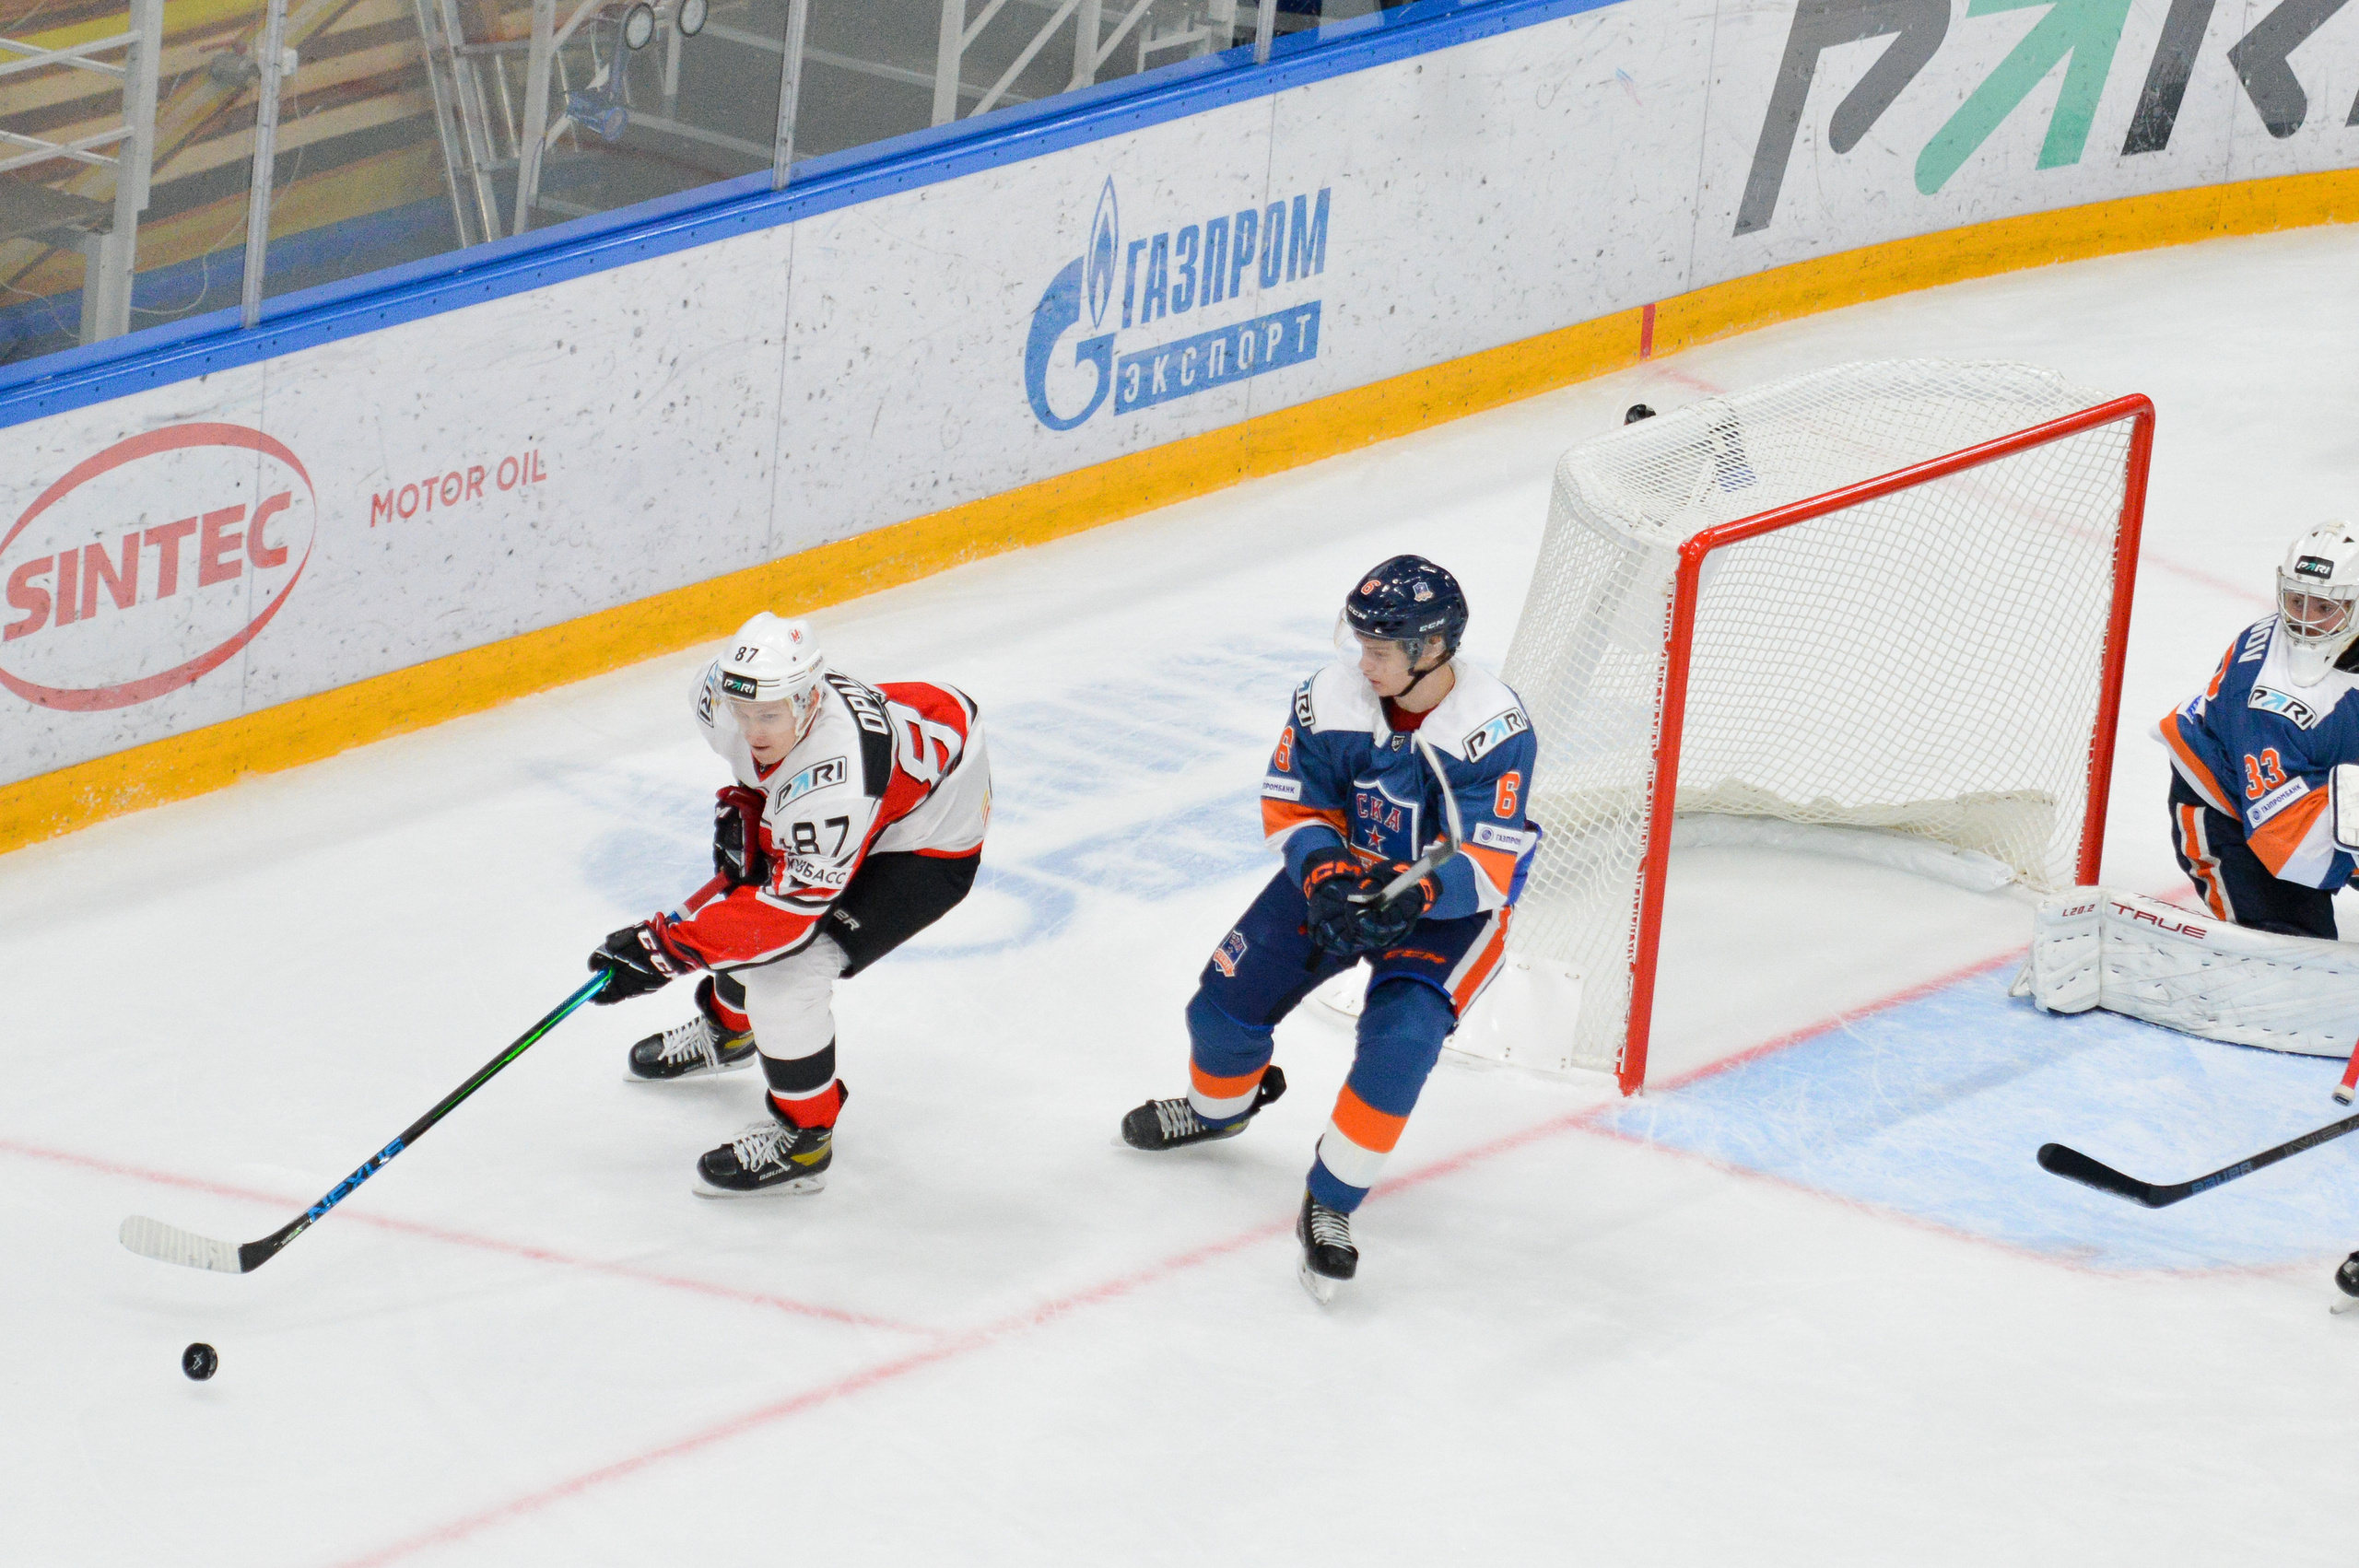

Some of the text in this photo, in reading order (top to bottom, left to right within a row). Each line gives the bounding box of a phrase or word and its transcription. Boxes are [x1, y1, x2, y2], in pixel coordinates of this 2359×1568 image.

[1121, 187, 1331, 330] ГАЗПРОМ
[1124, 314, 1310, 404] ЭКСПОРТ
[370, 450, 547, 528] MOTOR OIL
[3, 490, 292, 642] SINTEC
[1361, 579, 1381, 595] 6
[2296, 561, 2330, 575] PARI
[1347, 604, 1367, 620] CCM
[1418, 618, 1445, 632] CCM
[734, 646, 759, 663] 87
[2237, 614, 2279, 663] NOV
[723, 678, 755, 694] PARI
[2254, 689, 2314, 727] PARI
[1273, 725, 1294, 773] 6
[1467, 710, 1526, 758] PARI
[777, 760, 843, 809] PARI
[1493, 771, 1520, 819] 6
[2243, 748, 2287, 801] 33
[1356, 793, 1402, 833] СКА
[2260, 784, 2302, 814] ГАЗПРОМБАНК
[792, 815, 850, 859] 87
[2110, 902, 2207, 940] TRUE
